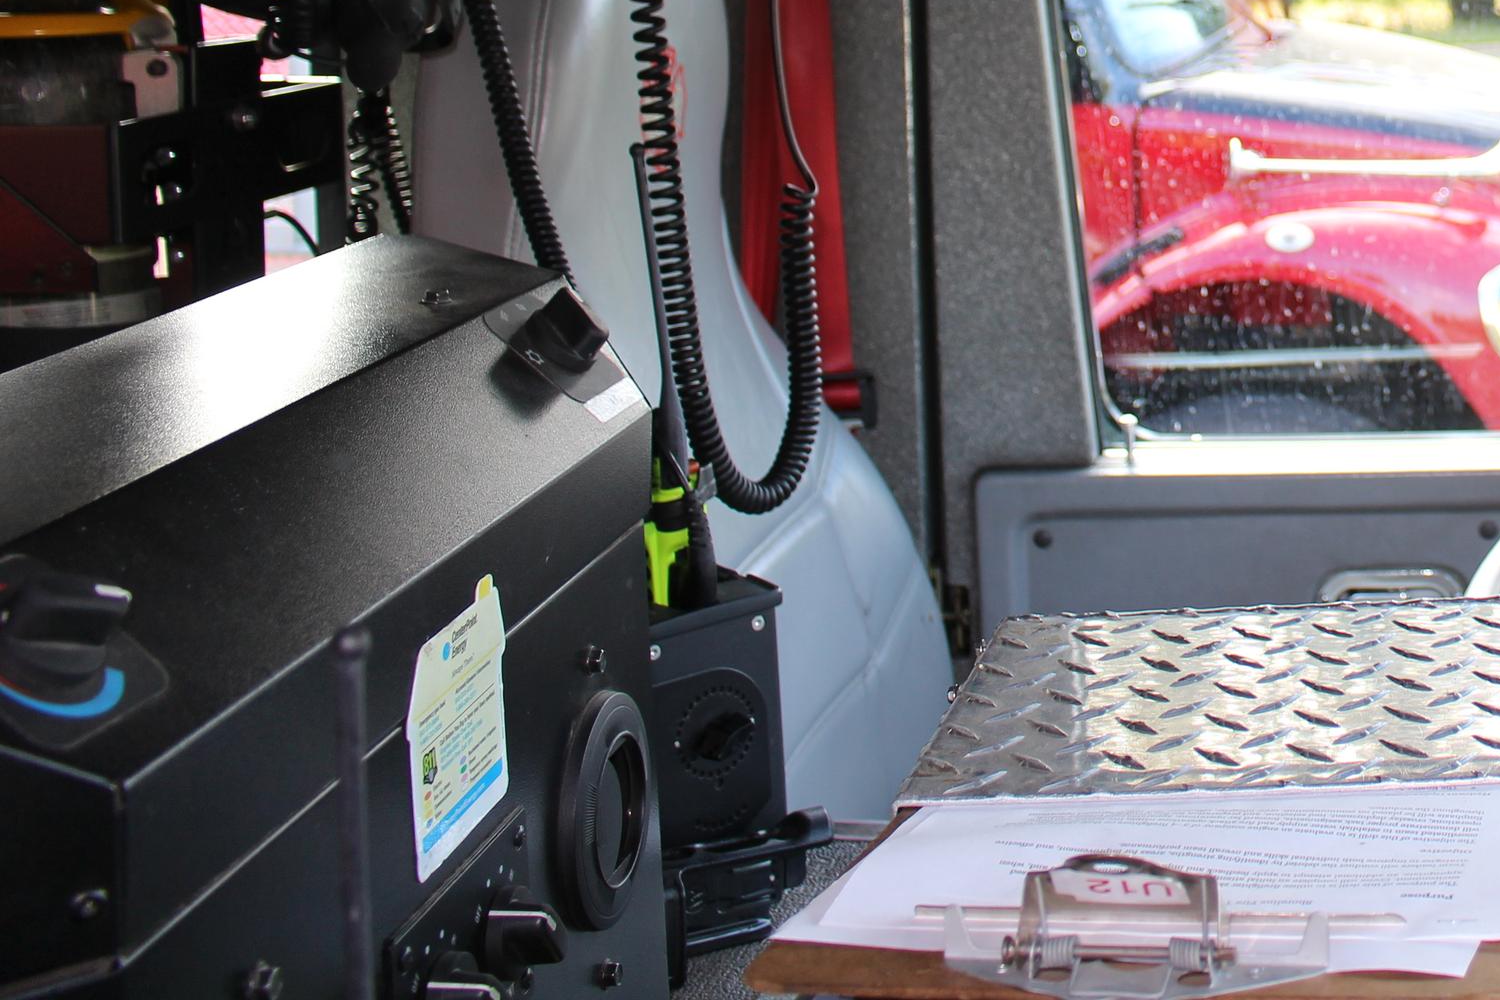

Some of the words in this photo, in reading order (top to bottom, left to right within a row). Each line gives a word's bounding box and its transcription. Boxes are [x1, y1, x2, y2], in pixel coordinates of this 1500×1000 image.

[451, 613, 478, 643] CenterPoint
[451, 638, 468, 659] Energy
[423, 750, 436, 777] 811
[1339, 825, 1381, 833] establish
[1056, 845, 1122, 854] improvement,
[1168, 851, 1216, 860] strengths,
[1217, 855, 1268, 865] identifying
[1208, 868, 1250, 876] feedback
[1085, 878, 1172, 898] U12
[1400, 892, 1453, 901] Purpose
